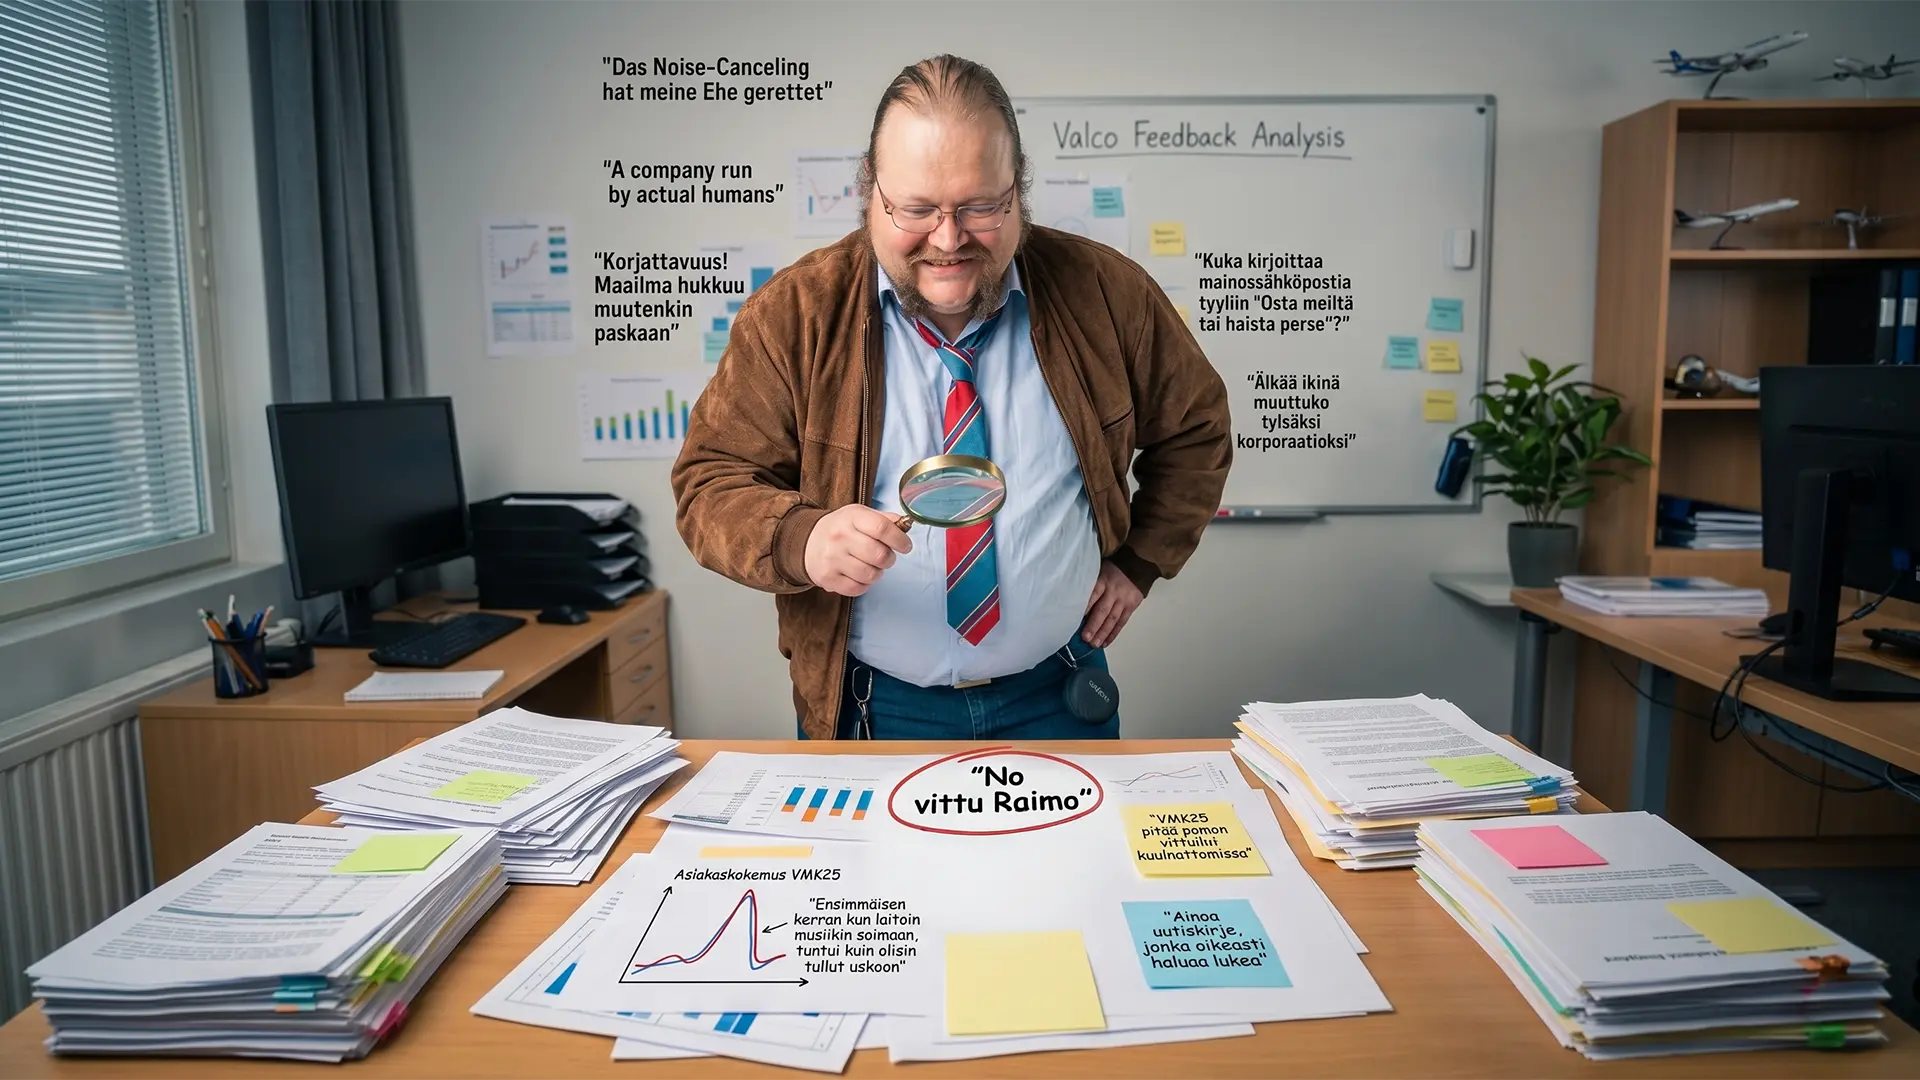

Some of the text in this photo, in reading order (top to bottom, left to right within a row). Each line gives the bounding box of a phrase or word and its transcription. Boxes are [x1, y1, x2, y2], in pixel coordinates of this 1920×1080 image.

[1054, 119, 1345, 157] Valco Feedback Analysis
[914, 793, 983, 814] vittu
[1141, 826, 1229, 839] pitää pomon
[673, 868, 842, 881] Asiakaskokemus VMK25
[793, 912, 921, 926] kerran kun laitoin
[794, 928, 920, 943] musiikin soimaan,
[796, 944, 917, 958] tuntui kuin olisin
[1142, 938, 1266, 957] jonka oikeasti
[805, 960, 845, 973] tullut
[1150, 954, 1209, 969] haluaa
